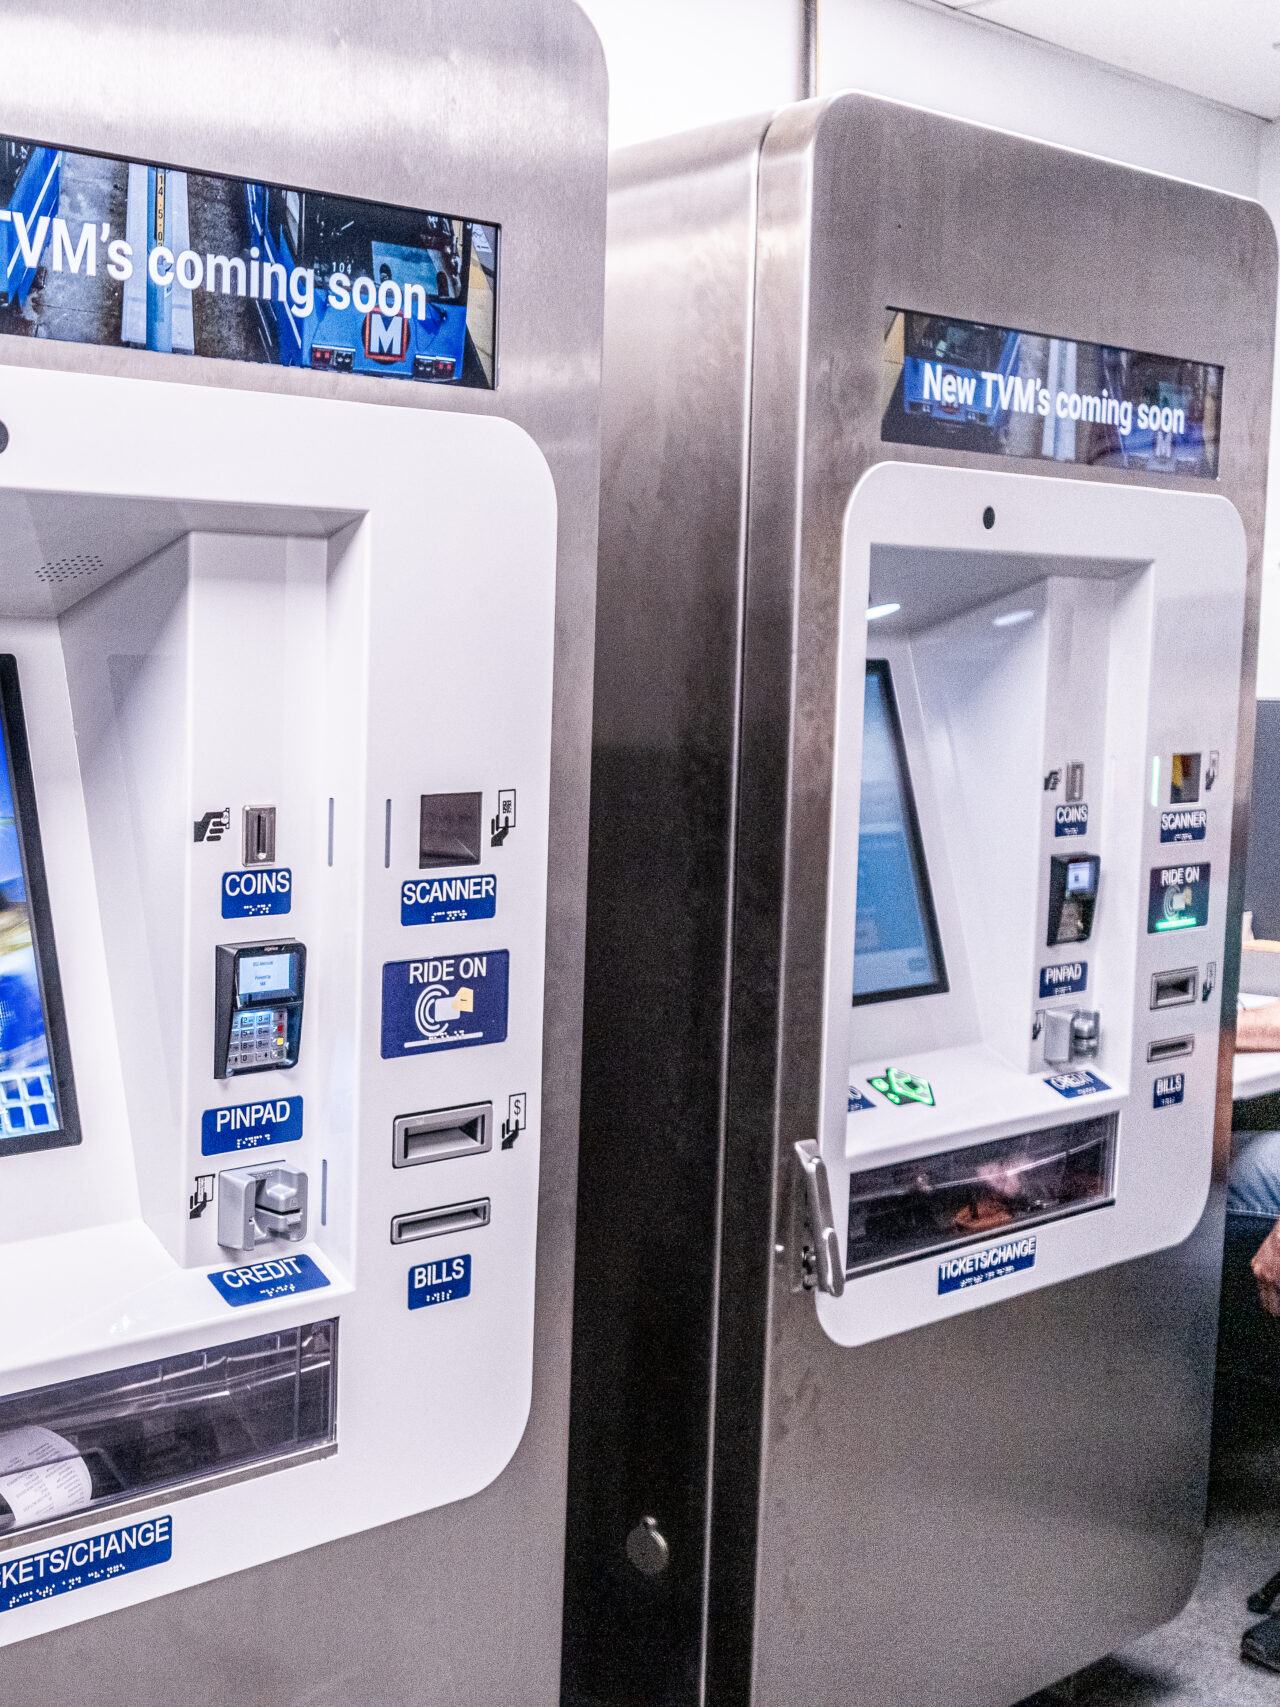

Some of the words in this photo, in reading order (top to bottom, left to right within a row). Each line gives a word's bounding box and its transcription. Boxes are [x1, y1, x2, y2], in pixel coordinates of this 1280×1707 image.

[332, 261, 352, 275] 104
[148, 245, 315, 319] coming
[328, 271, 426, 321] soon
[923, 362, 976, 405] New
[981, 371, 1050, 417] TVM's
[1056, 389, 1132, 436] coming
[1137, 403, 1185, 435] soon
[1056, 804, 1088, 824] COINS
[1161, 810, 1207, 831] SCANNER
[225, 870, 291, 898] COINS
[1160, 868, 1184, 887] RIDE
[1185, 866, 1200, 884] ON
[402, 876, 495, 905] SCANNER
[409, 961, 455, 984] RIDE
[459, 957, 487, 979] ON
[1046, 963, 1082, 985] PINPAD
[1050, 1070, 1095, 1090] CREDIT
[1156, 1074, 1183, 1095] BILLS
[216, 1100, 291, 1133] PINPAD
[940, 1236, 1037, 1279] TICKETS/CHANGE
[222, 1257, 303, 1289] CREDIT
[413, 1258, 465, 1290] BILLS
